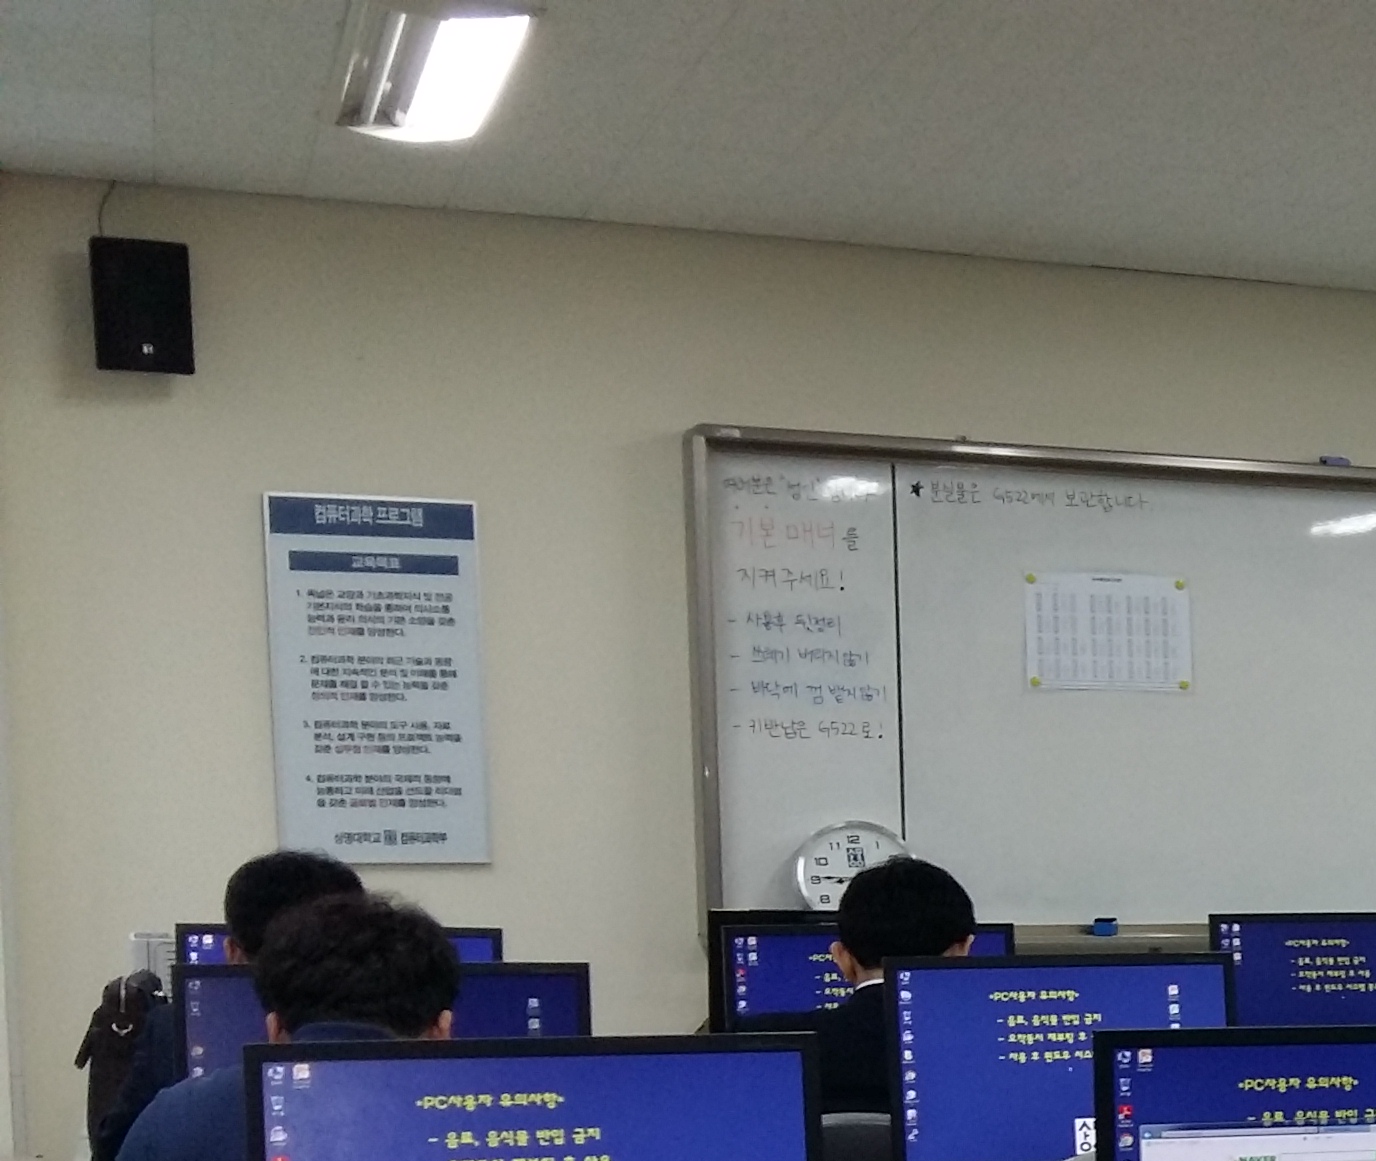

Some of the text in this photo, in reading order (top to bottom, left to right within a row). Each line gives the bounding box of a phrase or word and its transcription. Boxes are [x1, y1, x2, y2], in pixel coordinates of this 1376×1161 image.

[930, 481, 981, 504] 분실물은
[314, 504, 424, 527] 컴퓨터과학 프로그램
[730, 516, 777, 548] 기본
[751, 680, 798, 699] 바닥에
[806, 684, 824, 704] 껌
[829, 842, 840, 851] 11
[847, 835, 860, 844] 12
[815, 857, 829, 866] 10
[820, 894, 831, 904] 8
[1075, 1050, 1093, 1059] 시스
[445, 1127, 600, 1148] 음료, 음식물 반입 금지
